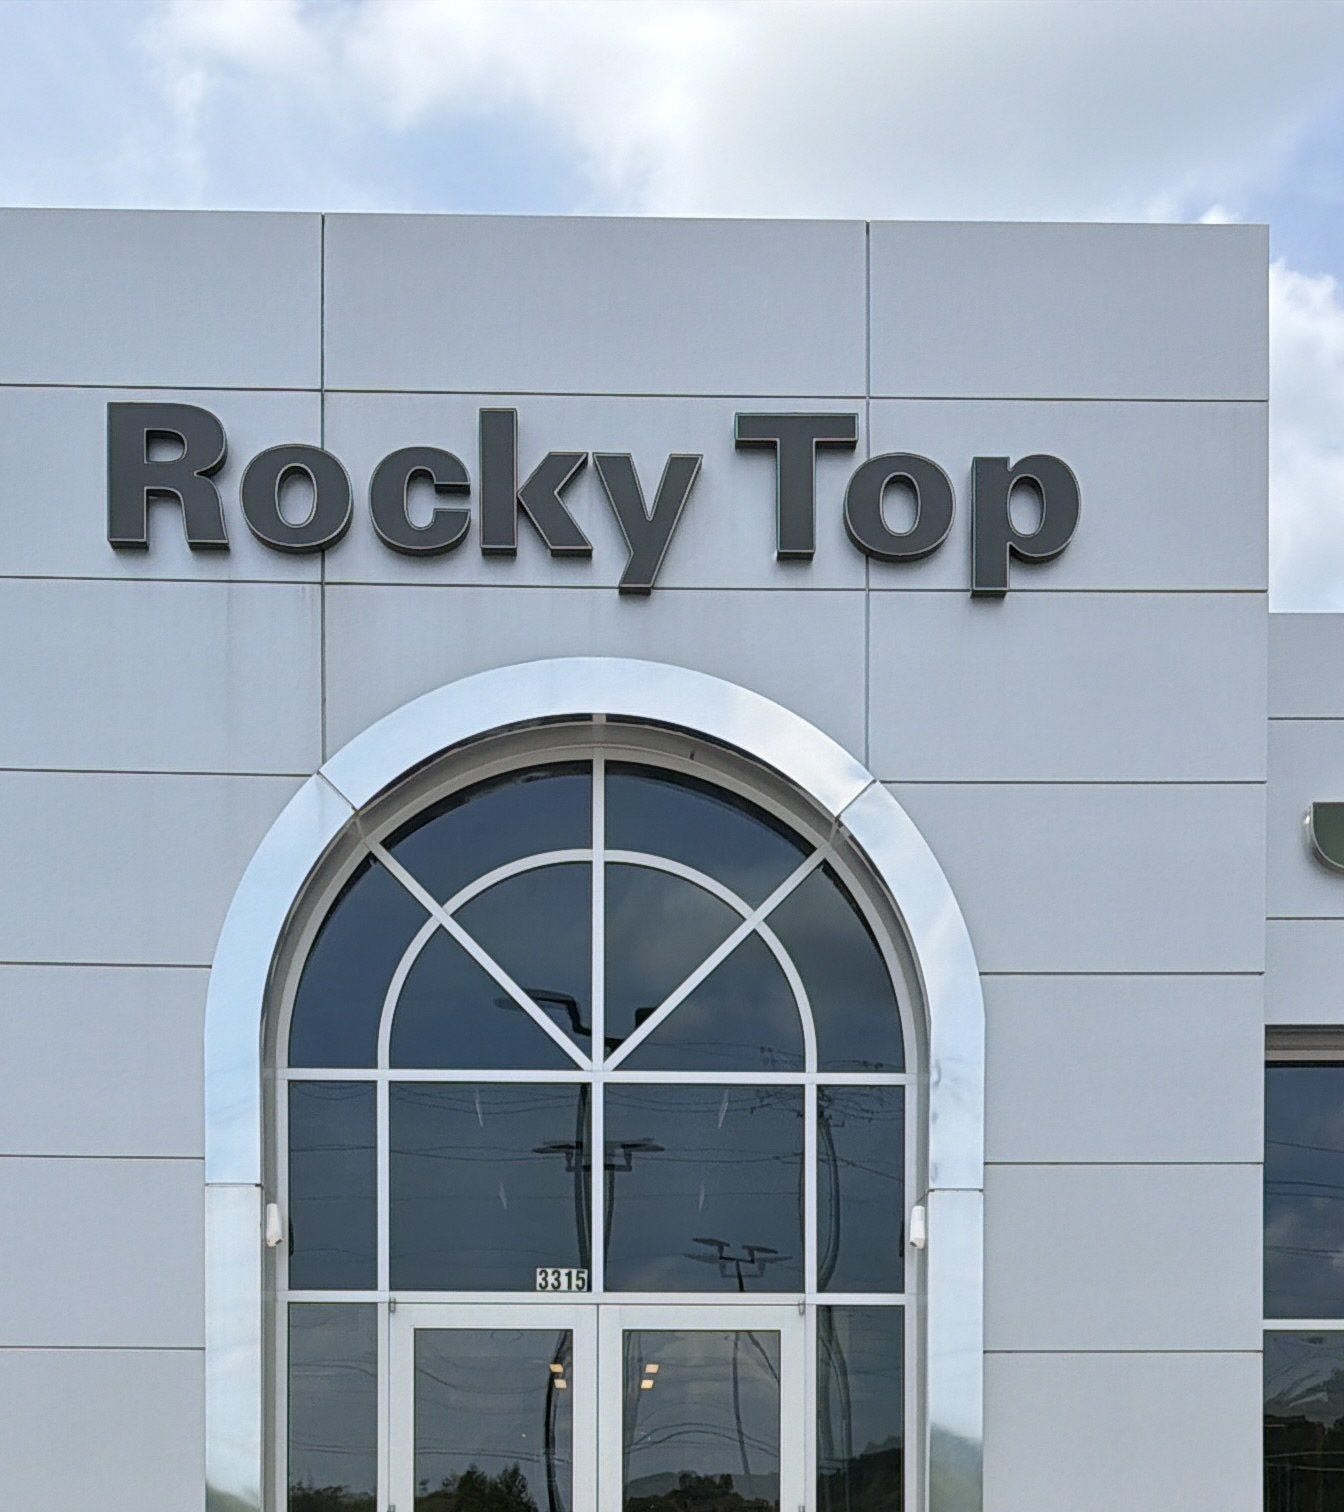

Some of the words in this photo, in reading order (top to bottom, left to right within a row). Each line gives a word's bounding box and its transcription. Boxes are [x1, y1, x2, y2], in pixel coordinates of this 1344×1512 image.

[107, 401, 704, 594] Rocky
[733, 411, 1082, 599] Top
[538, 1269, 586, 1290] 3315
